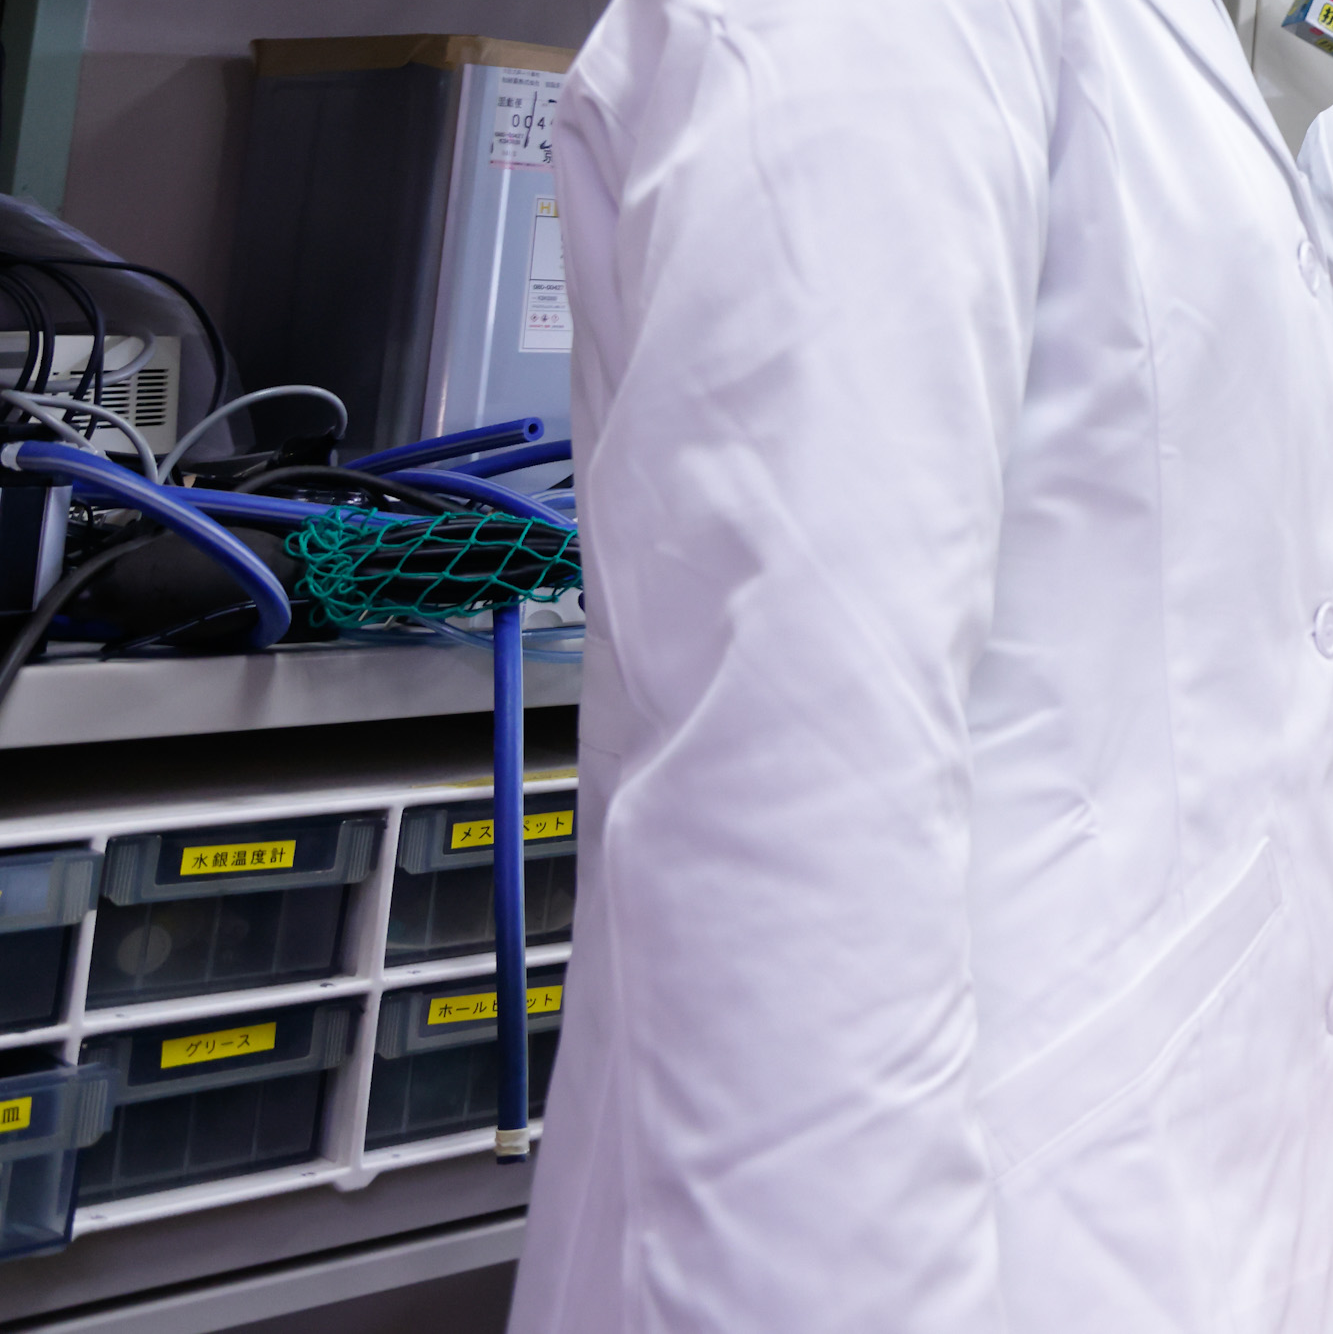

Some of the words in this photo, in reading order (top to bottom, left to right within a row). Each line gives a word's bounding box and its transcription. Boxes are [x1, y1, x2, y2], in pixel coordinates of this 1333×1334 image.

[192, 847, 286, 869] 水銀温度計
[186, 1034, 250, 1058] グリース
